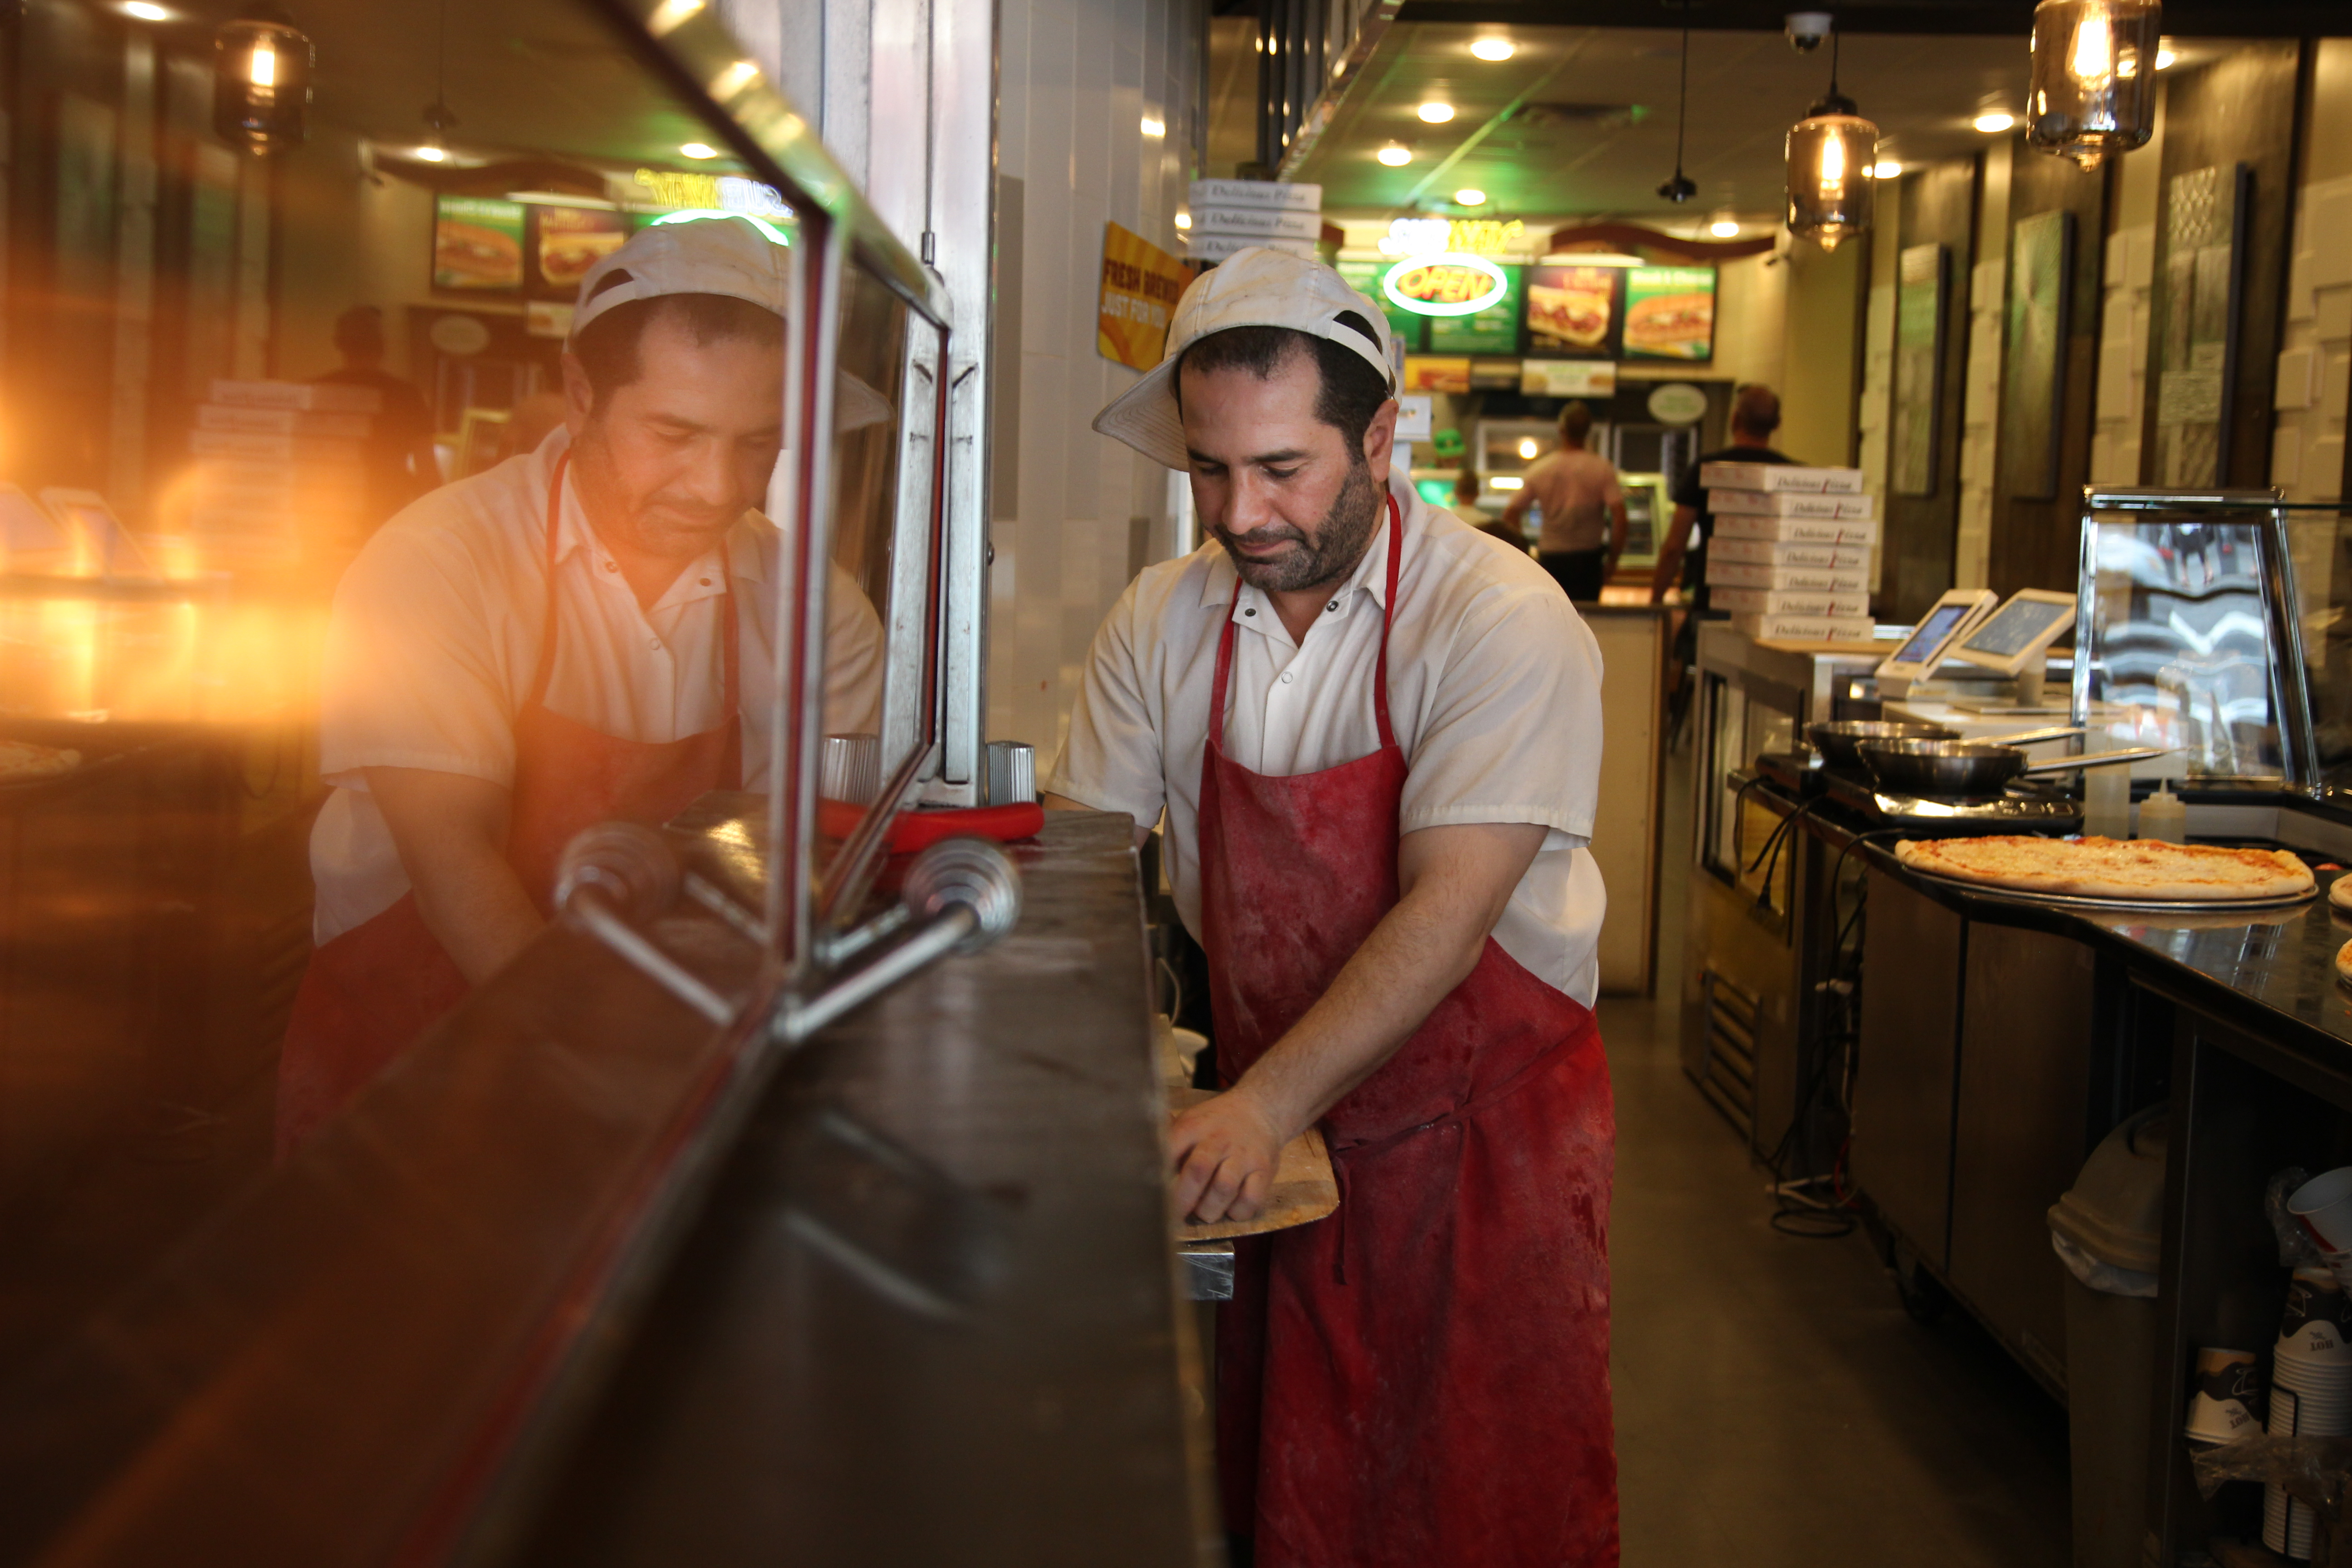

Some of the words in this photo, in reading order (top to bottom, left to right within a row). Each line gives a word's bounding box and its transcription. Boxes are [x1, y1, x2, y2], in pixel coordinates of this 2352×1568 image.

[1211, 212, 1271, 227] Delicious
[1103, 256, 1141, 293] FRESH
[1398, 265, 1493, 303] OPEN
[1102, 291, 1129, 318] JUST
[1130, 298, 1149, 324] FOR
[1778, 477, 1821, 488] Delicious
[1774, 624, 1825, 635] Delicious
